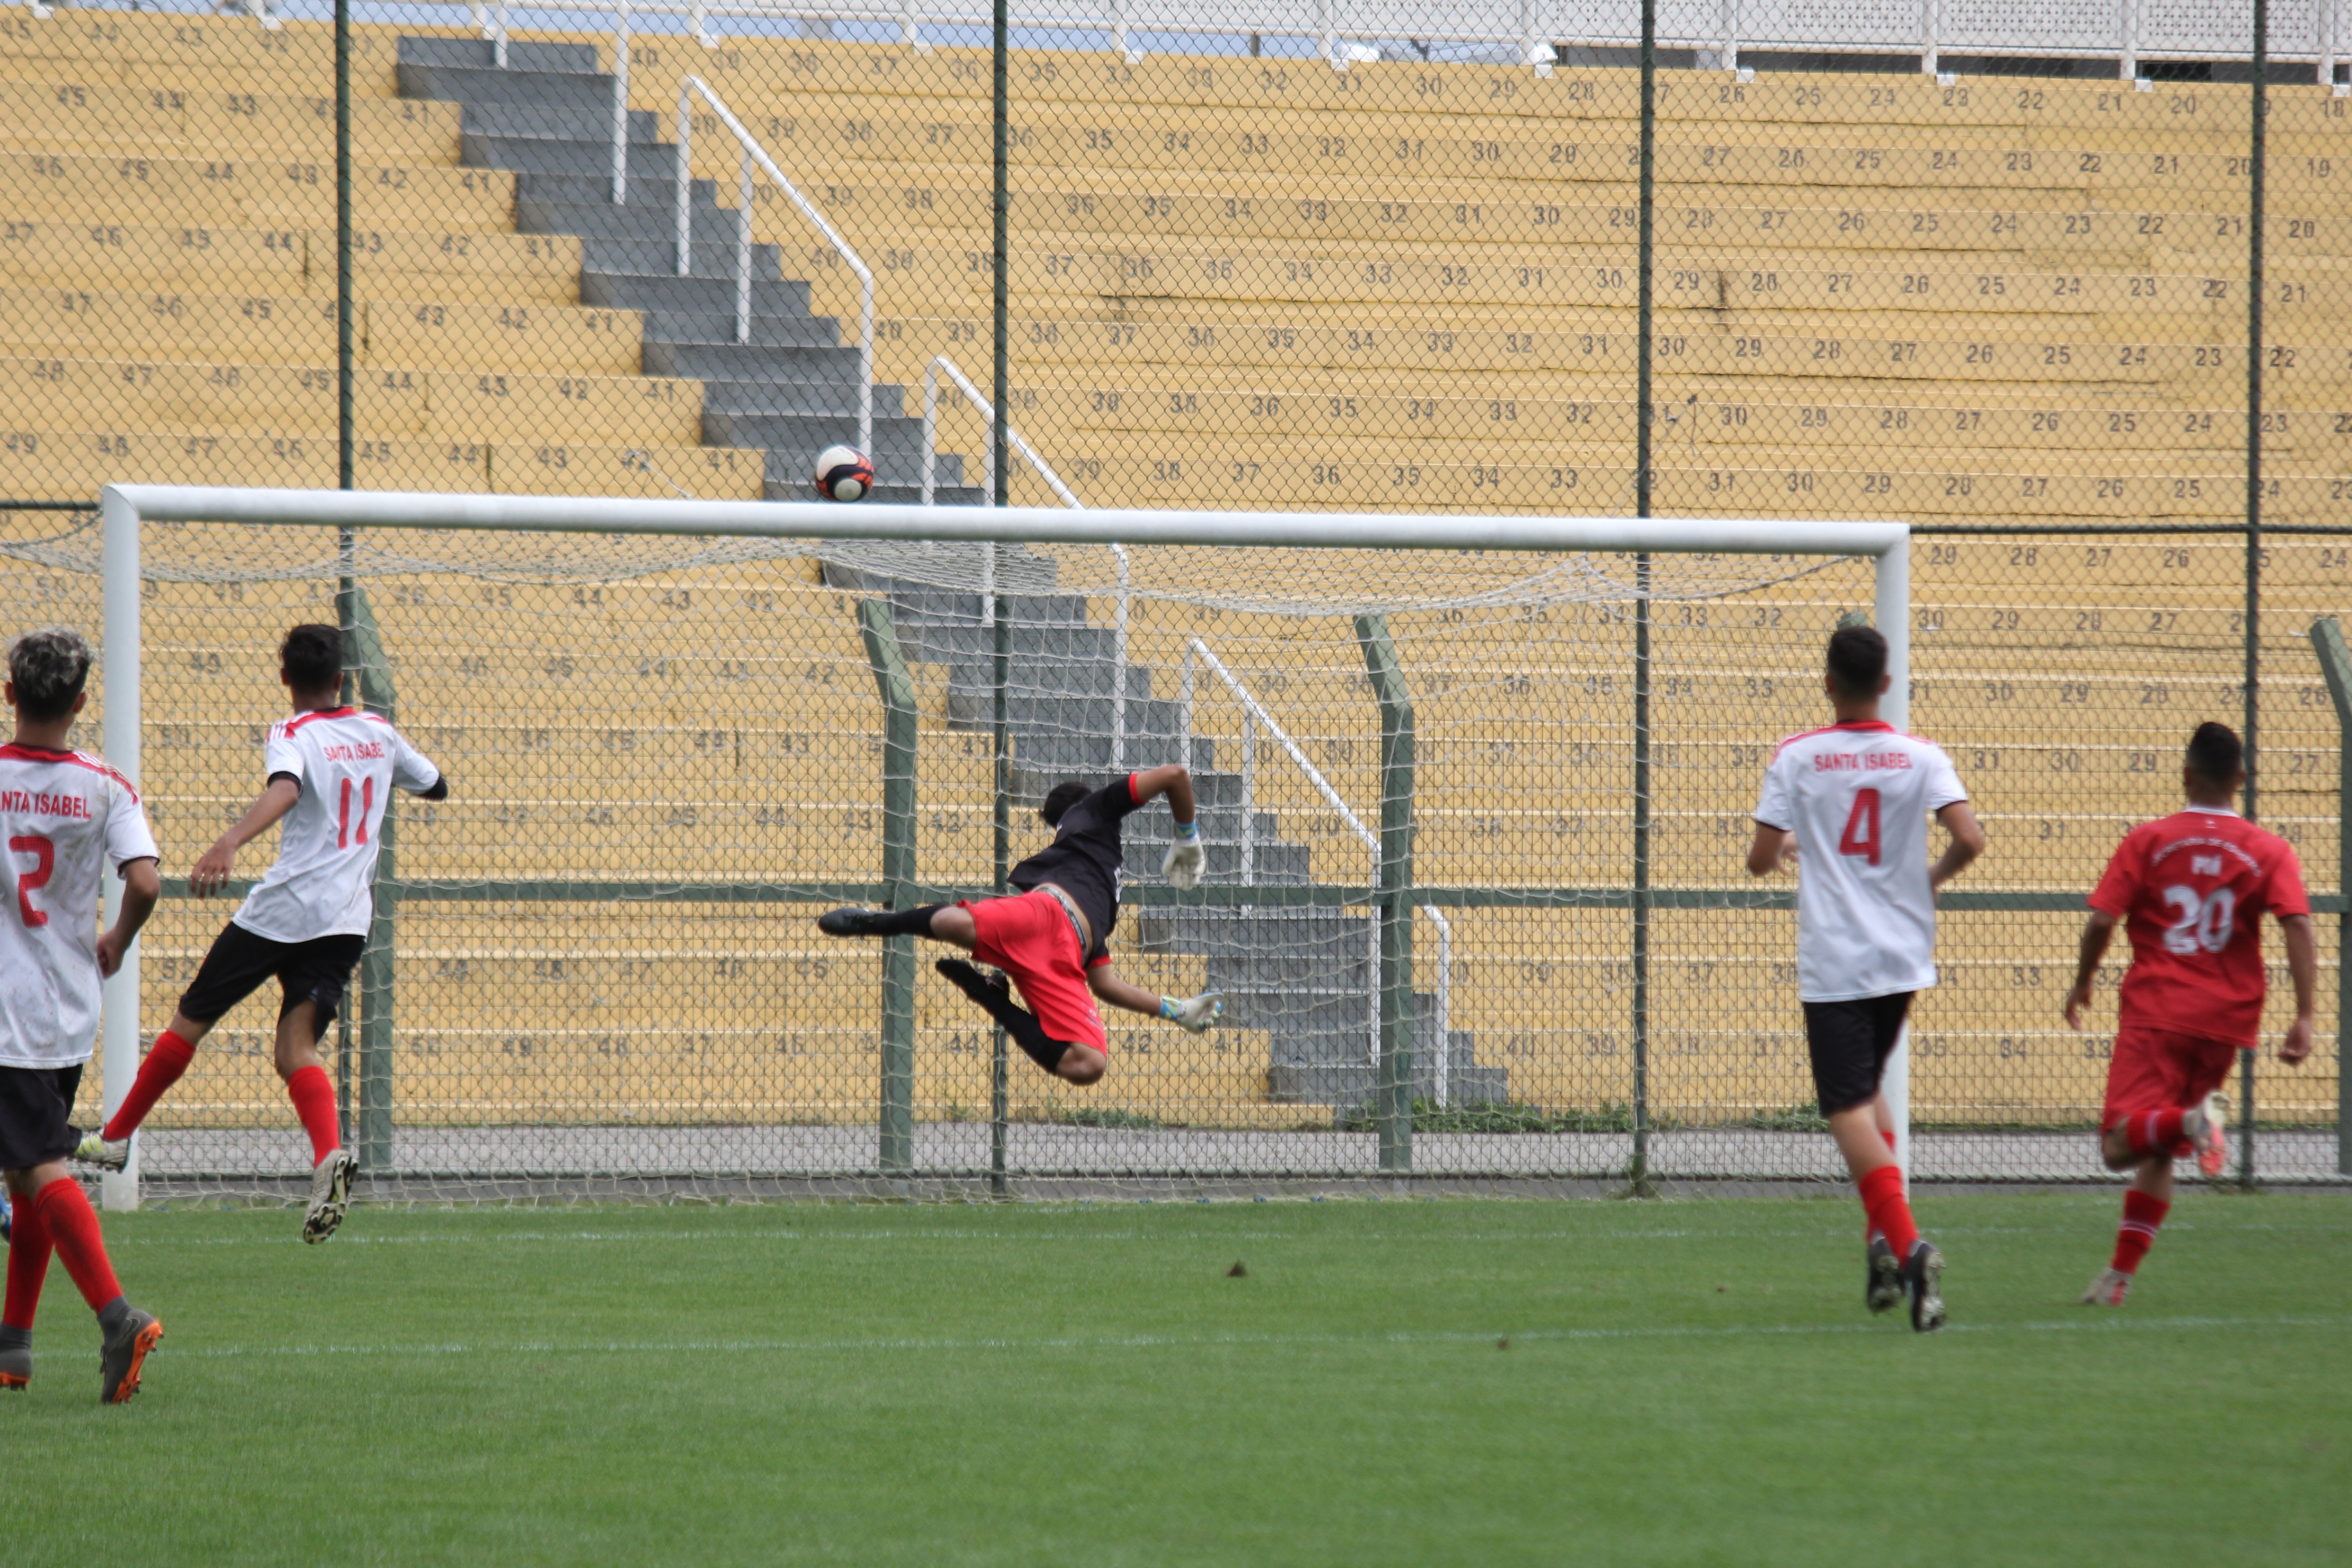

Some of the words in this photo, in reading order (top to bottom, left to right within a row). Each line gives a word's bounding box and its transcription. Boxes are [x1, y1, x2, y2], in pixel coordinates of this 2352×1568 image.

[1029, 62, 1057, 83] 35
[1261, 70, 1287, 91] 32
[1416, 76, 1442, 96] 30
[1490, 79, 1518, 98] 29
[1720, 86, 1745, 103] 26
[1795, 86, 1821, 107] 25
[1871, 89, 1896, 106] 24
[1943, 89, 1968, 107] 23
[2018, 89, 2043, 111] 22
[2098, 95, 2121, 111] 21
[2171, 95, 2197, 115] 20
[2322, 99, 2344, 117] 18
[767, 117, 795, 138] 39
[927, 123, 953, 144] 37
[1086, 129, 1113, 150] 35
[1164, 132, 1190, 152] 34
[1242, 133, 1269, 154] 33
[1319, 137, 1345, 157] 32
[1395, 139, 1424, 159] 31
[1471, 141, 1501, 161] 30
[1549, 144, 1578, 163] 29
[1702, 146, 1731, 167] 27
[1779, 148, 1805, 168] 26
[1855, 150, 1881, 169] 25
[1932, 151, 1957, 169] 24
[2005, 152, 2033, 172] 23
[2079, 153, 2100, 173] 22
[2154, 155, 2178, 174] 21
[2308, 159, 2331, 178] 19
[903, 188, 933, 209] 38
[1064, 194, 1095, 215] 36
[1144, 196, 1171, 217] 35
[1225, 199, 1251, 218] 34
[1300, 200, 1328, 221] 33
[1380, 203, 1407, 222] 32
[1455, 204, 1480, 224] 31
[1534, 206, 1560, 225] 30
[1610, 209, 1636, 228] 29
[1686, 209, 1715, 229] 28
[1761, 211, 1787, 229] 27
[1838, 211, 1865, 231] 26
[1912, 213, 1939, 232] 25
[1991, 213, 2017, 234] 24
[2065, 215, 2091, 234] 23
[2138, 216, 2164, 235] 22
[2217, 217, 2242, 236] 21
[2289, 220, 2315, 238] 20
[440, 235, 469, 255] 42
[883, 250, 912, 271] 39
[1046, 255, 1074, 275] 37
[1126, 258, 1153, 277] 36
[1206, 260, 1234, 280] 35
[1287, 263, 1313, 281] 34
[1366, 264, 1392, 284] 33
[1442, 266, 1467, 286] 32
[1519, 268, 1543, 287] 31
[1597, 269, 1623, 289] 30
[1674, 272, 1700, 290] 29
[1752, 272, 1778, 292] 28
[1828, 274, 1852, 293] 27
[1902, 274, 1929, 294] 26
[1977, 275, 2005, 295] 25
[2054, 277, 2081, 295] 24
[2130, 277, 2157, 297] 23
[2203, 279, 2225, 299] 22
[2281, 284, 2305, 303] 21
[415, 305, 445, 327] 43
[499, 308, 527, 330] 42
[949, 322, 975, 342] 39
[1030, 323, 1058, 343] 38
[1110, 325, 1135, 345] 37
[1189, 327, 1215, 347] 36
[1268, 329, 1294, 349] 35
[1348, 331, 1374, 351] 34
[1427, 332, 1453, 353] 33
[1506, 333, 1533, 353] 32
[1582, 334, 1608, 355] 31
[1658, 336, 1686, 356] 30
[1735, 338, 1762, 357] 29
[1813, 340, 1841, 360] 28
[1890, 342, 1916, 362] 27
[1966, 343, 1994, 363] 26
[2043, 345, 2071, 365] 25
[2119, 347, 2147, 366] 24
[2195, 347, 2223, 367] 23
[2270, 346, 2293, 368] 22
[559, 379, 587, 400] 42
[1170, 394, 1198, 413] 38
[1250, 396, 1280, 416] 36
[1329, 397, 1358, 418] 35
[1408, 400, 1434, 420] 34
[1489, 401, 1518, 421] 33
[1566, 403, 1592, 424] 32
[1719, 406, 1748, 426] 30
[1801, 407, 1828, 427] 29
[1880, 409, 1908, 429] 28
[1956, 411, 1981, 431] 27
[2032, 412, 2059, 431] 26
[2109, 412, 2136, 432] 25
[2185, 413, 2212, 432] 24
[538, 448, 568, 469] 43
[1073, 459, 1101, 480] 39
[1154, 461, 1181, 480] 38
[1232, 462, 1262, 482] 37
[1311, 465, 1342, 485] 36
[1392, 466, 1420, 487] 35
[1474, 467, 1499, 488] 34
[1550, 469, 1578, 489] 33
[1710, 472, 1735, 491] 31
[1787, 471, 1813, 492] 30
[1863, 474, 1892, 494] 29
[1945, 476, 1972, 496] 28
[2023, 477, 2048, 496] 27
[2097, 478, 2123, 498] 26
[2174, 479, 2200, 498] 25
[1931, 545, 1957, 565] 29
[2010, 546, 2038, 566] 28
[2087, 548, 2112, 567] 27
[2163, 549, 2189, 568] 26
[2319, 549, 2347, 568] 24
[1681, 606, 1708, 628] 33
[1754, 607, 1783, 627] 32
[1918, 609, 1944, 630] 30
[1991, 610, 2020, 631] 29
[2076, 611, 2102, 632] 28
[2149, 612, 2177, 631] 27
[1745, 678, 1774, 698] 33
[2060, 683, 2090, 703] 29
[1814, 753, 1860, 772] SANTA
[1864, 752, 1913, 770] ISABEL
[1974, 750, 1999, 769] 31
[2051, 751, 2079, 771] 30
[2128, 752, 2157, 773] 29
[0, 791, 30, 814] NTA
[34, 793, 92, 819] ISABEL
[338, 777, 373, 849] 11
[1839, 788, 1881, 867] 4
[2038, 820, 2066, 841] 31
[9, 836, 55, 927] 2
[2161, 886, 2235, 956] 20
[2012, 965, 2041, 985] 33
